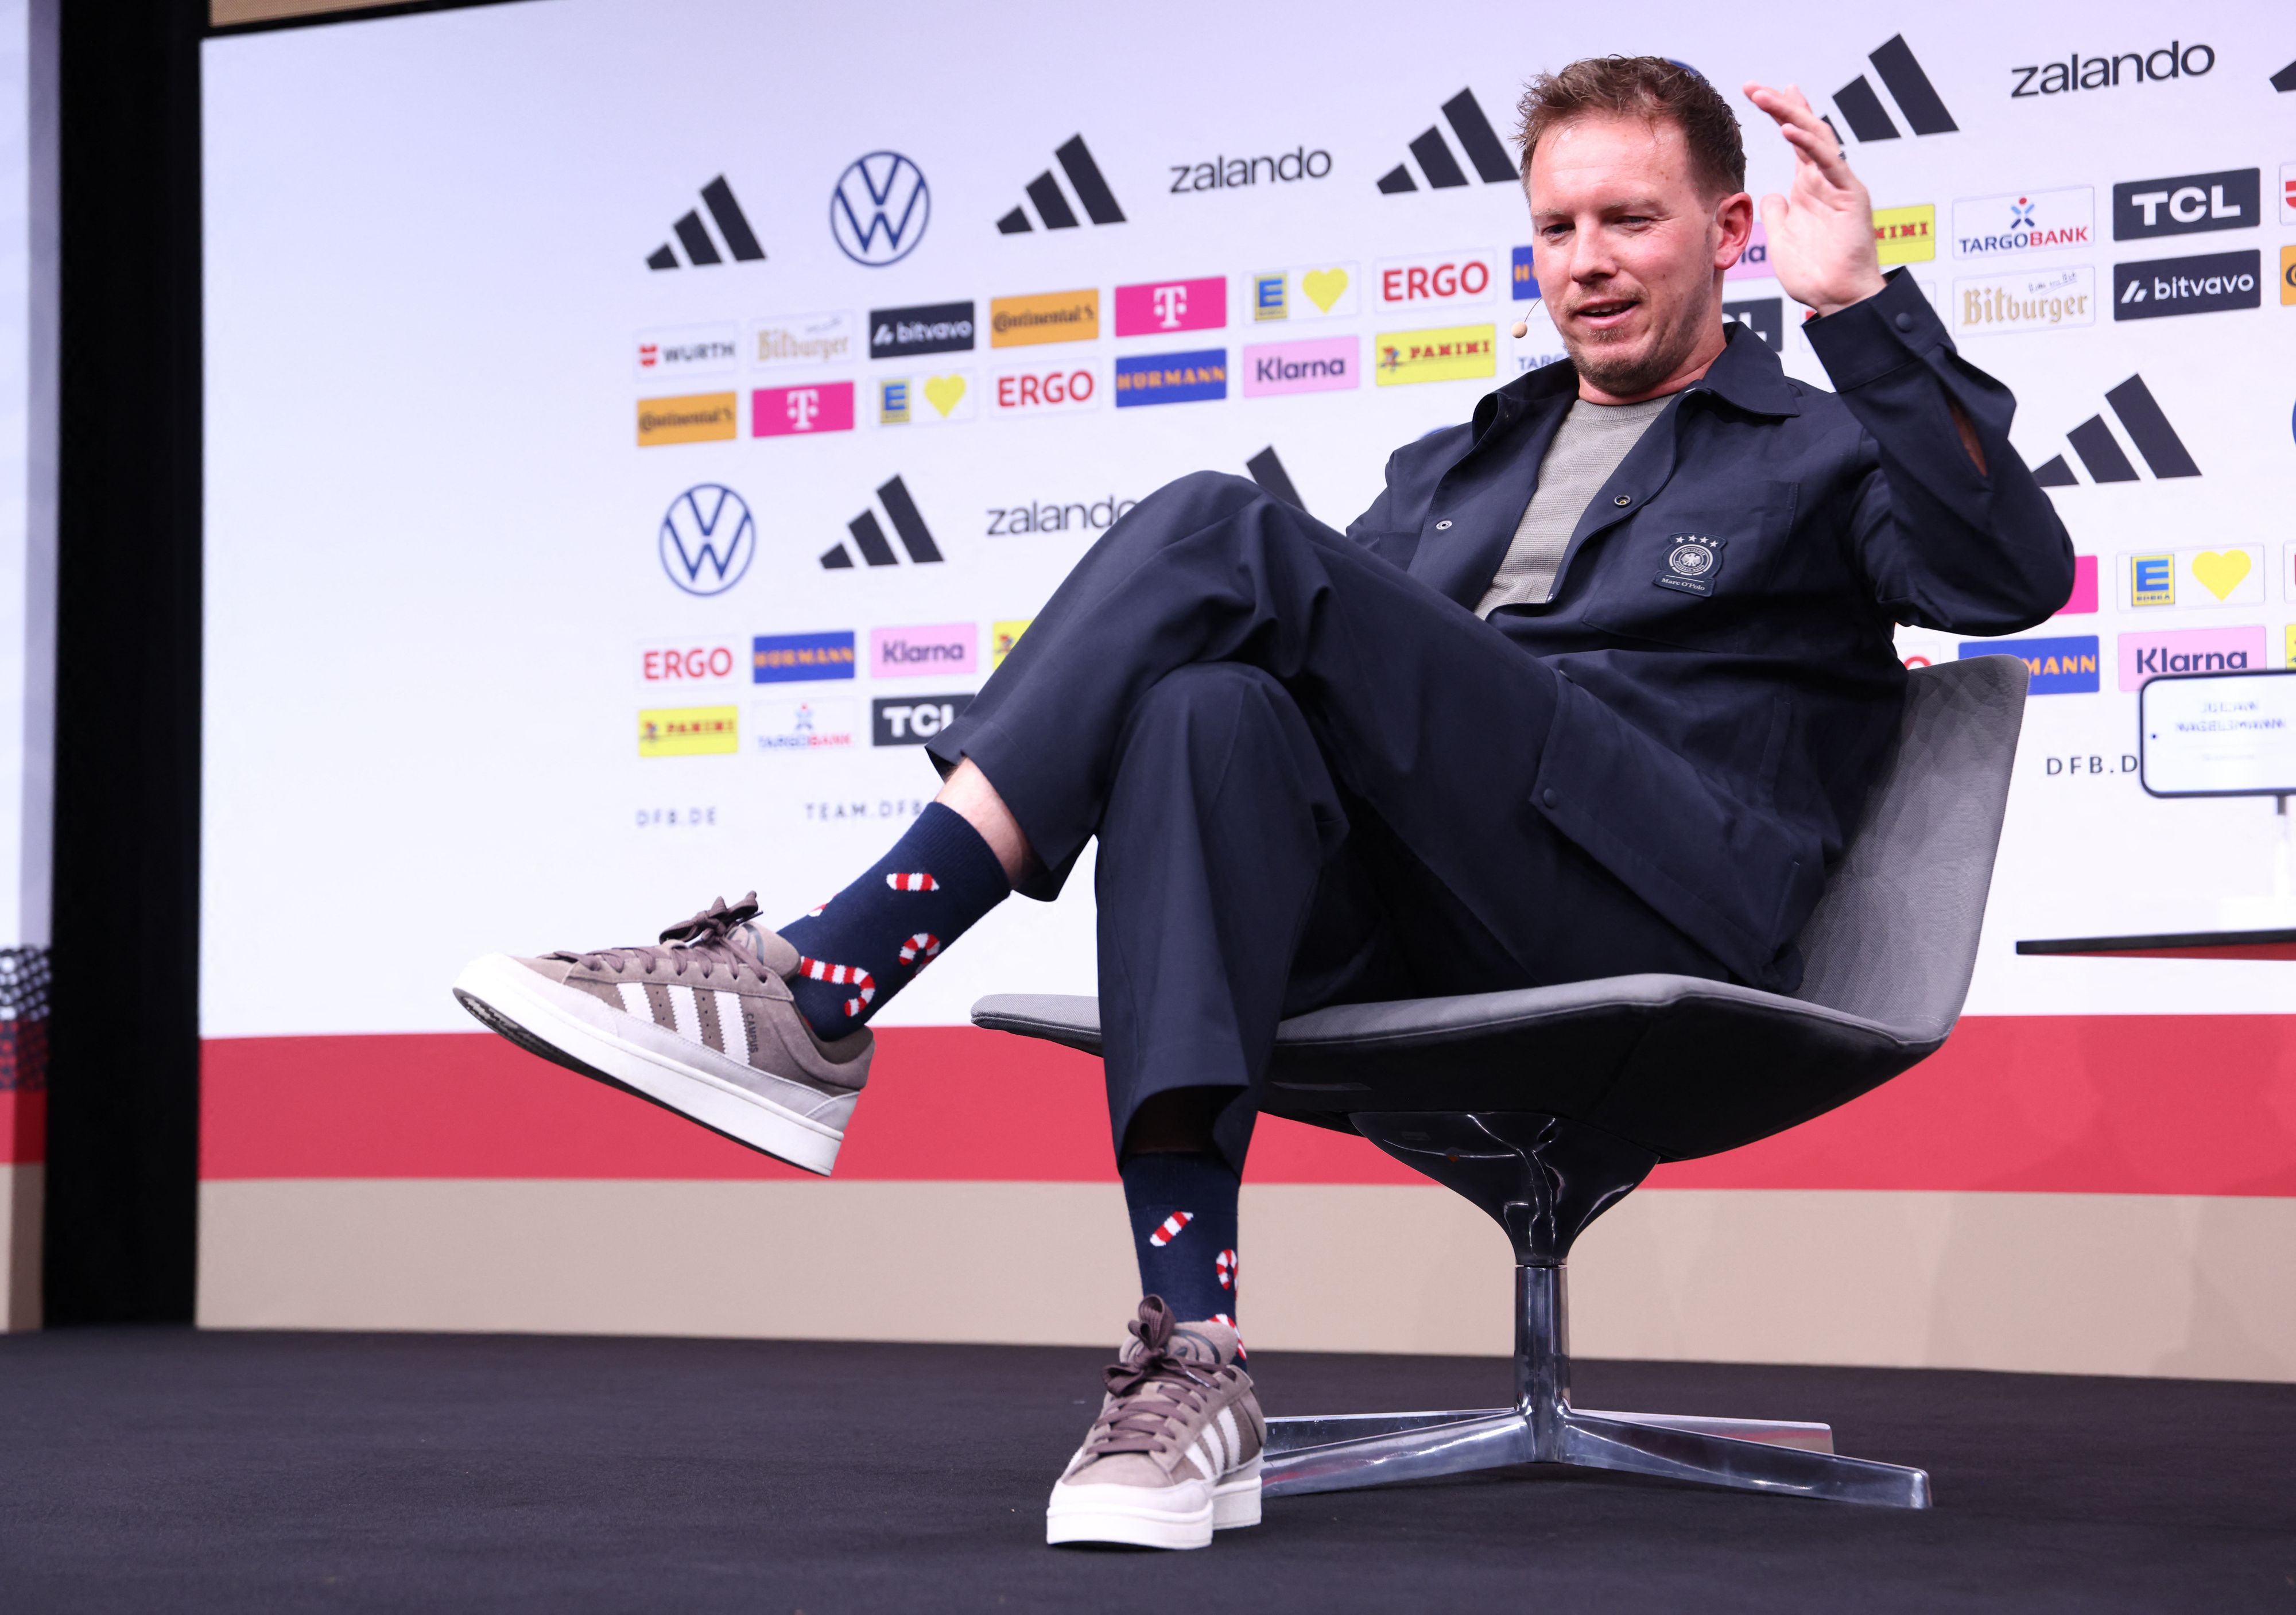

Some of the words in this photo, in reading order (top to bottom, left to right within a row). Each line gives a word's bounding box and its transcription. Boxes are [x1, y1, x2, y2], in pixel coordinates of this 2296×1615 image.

[2011, 40, 2215, 98] zalando
[1169, 146, 1333, 193] zalando
[831, 150, 930, 267] VW
[2131, 184, 2241, 226] TCL
[1874, 222, 1927, 239] NINI
[1959, 226, 2089, 254] TARGOBANK
[1383, 261, 1489, 302] ERGO
[2154, 274, 2255, 301] bitvavo
[1153, 285, 1188, 329] T
[1962, 286, 2088, 326] Bitburger
[896, 320, 972, 344] bitvavo
[1409, 339, 1491, 360] PANINI
[1257, 356, 1345, 383] Klarna
[998, 369, 1094, 407] ERGO
[786, 389, 819, 430] T
[659, 483, 756, 597] VW
[2136, 560, 2169, 592] E
[643, 647, 734, 680] ERGO
[882, 640, 965, 664] Klarna
[2023, 654, 2096, 676] MANN
[2136, 647, 2248, 674] Klarna
[2046, 755, 2139, 775] DFB.D
[805, 799, 922, 820] TEAM.DFB
[746, 1012, 759, 1053] CAMPUS
